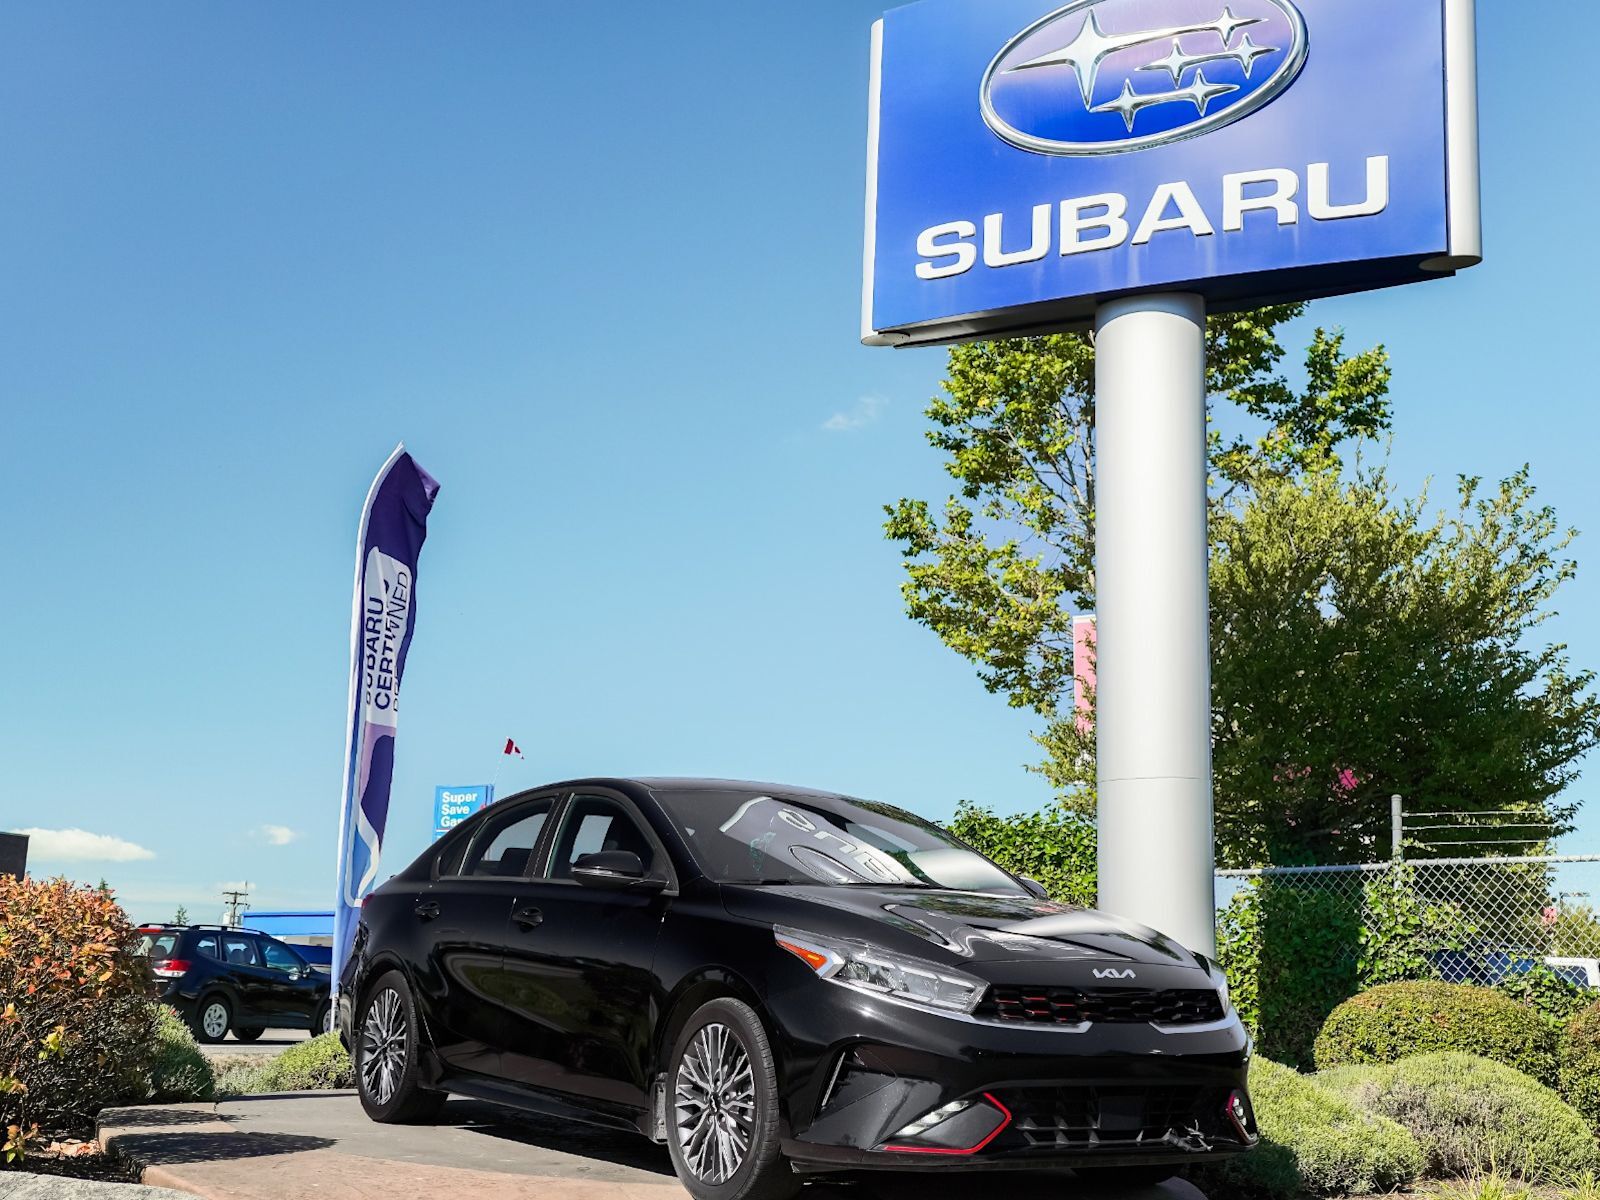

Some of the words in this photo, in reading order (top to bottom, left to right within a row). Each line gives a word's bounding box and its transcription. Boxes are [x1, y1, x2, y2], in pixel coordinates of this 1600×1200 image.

[914, 155, 1389, 280] SUBARU
[442, 791, 478, 804] Super
[441, 804, 470, 815] Save
